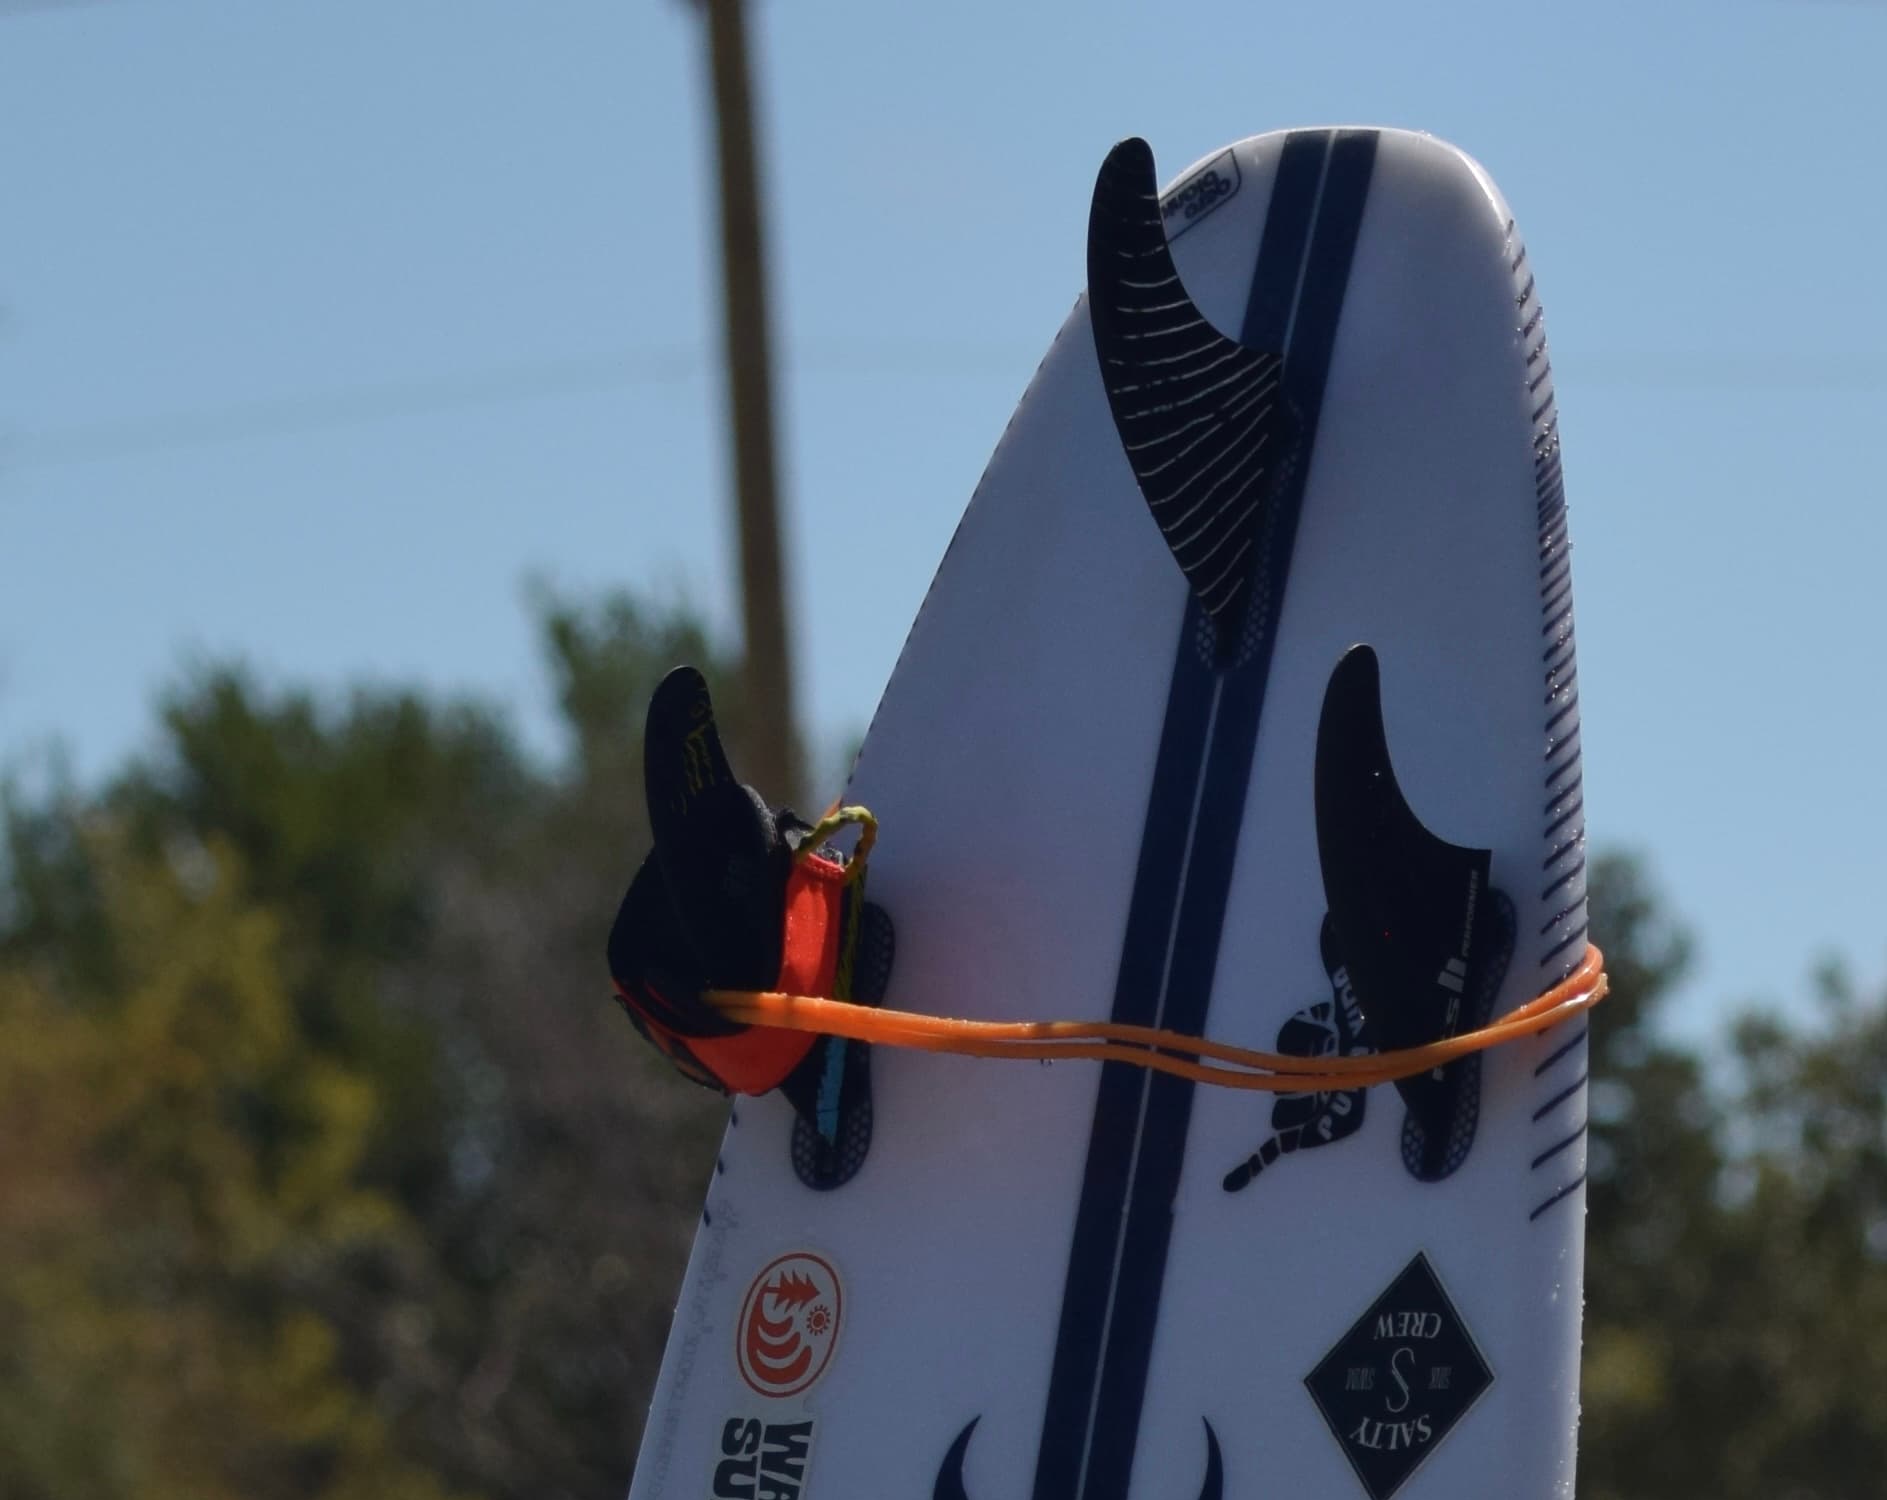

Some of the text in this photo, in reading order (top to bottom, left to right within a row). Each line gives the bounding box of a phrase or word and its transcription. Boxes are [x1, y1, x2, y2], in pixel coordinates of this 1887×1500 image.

[1461, 869, 1478, 957] PERFORMER
[1377, 1312, 1442, 1339] CREW
[1350, 1414, 1432, 1449] SALTY
